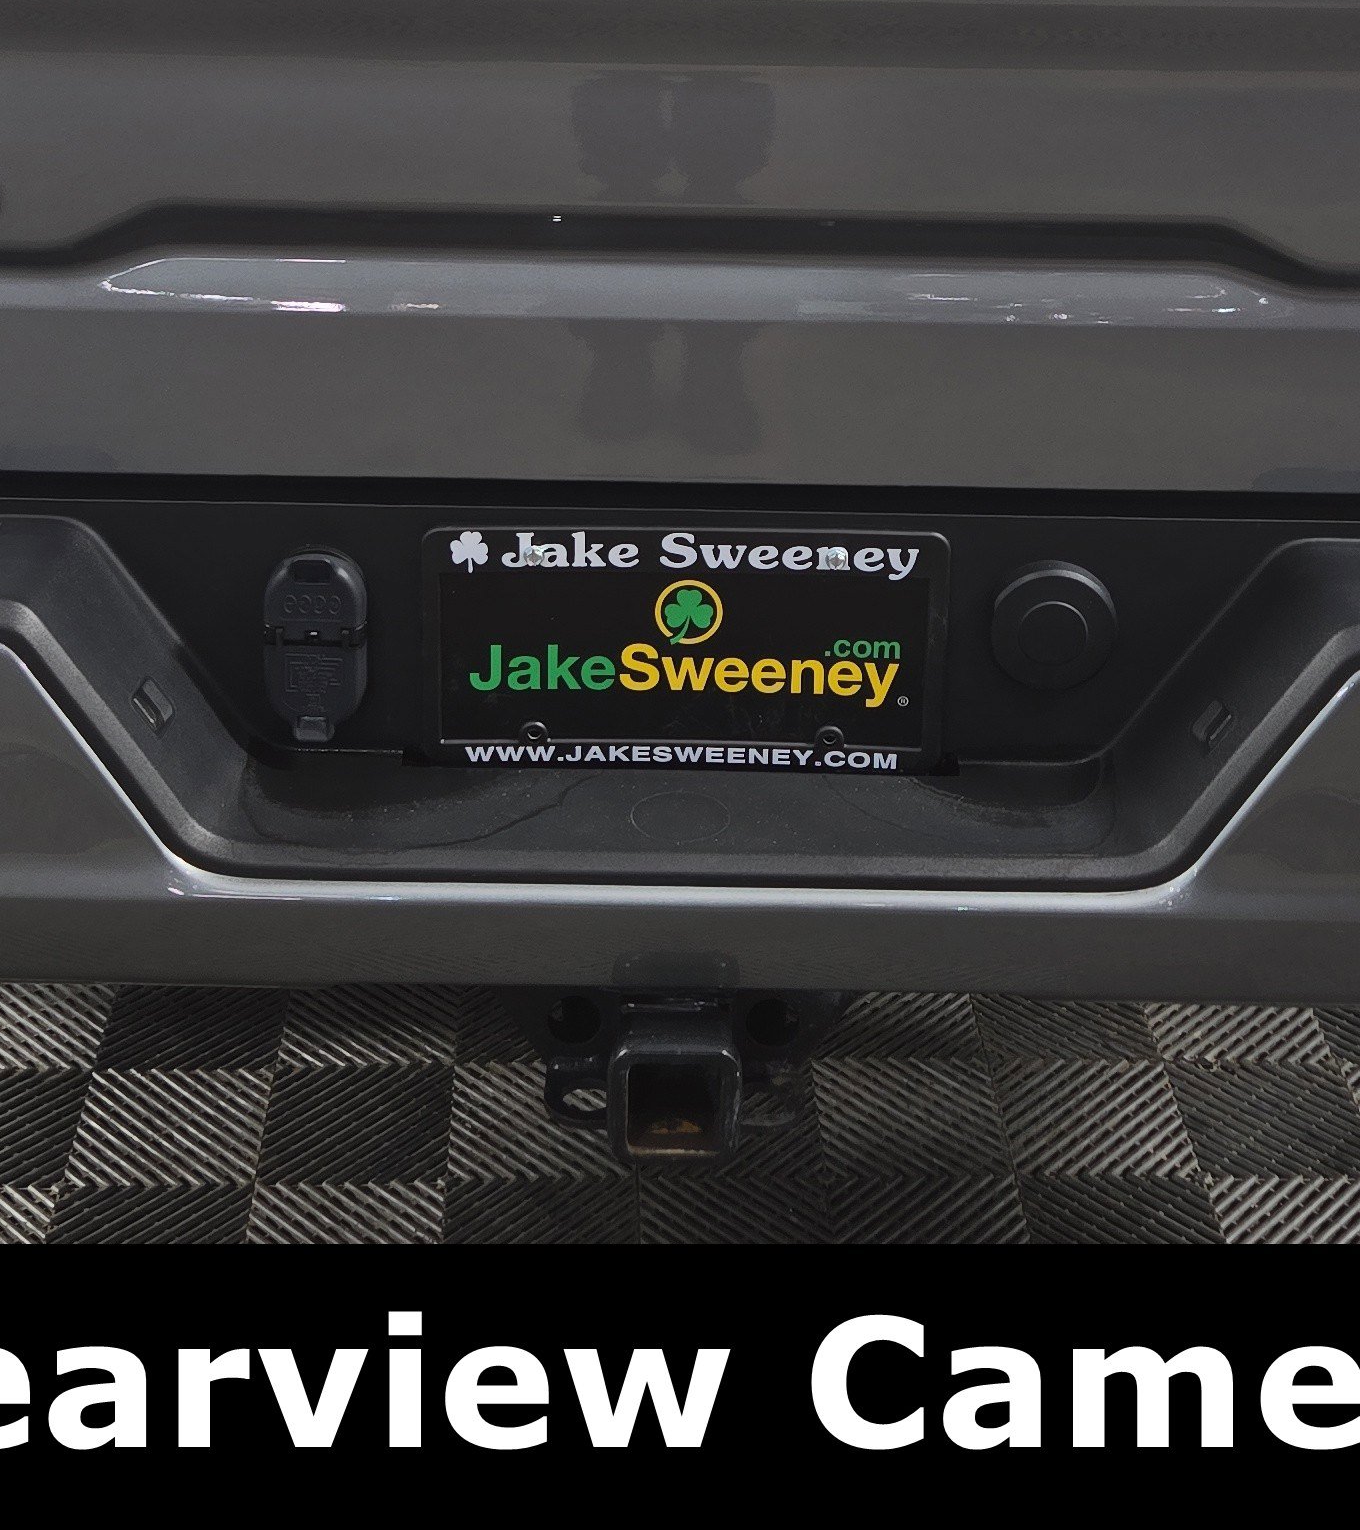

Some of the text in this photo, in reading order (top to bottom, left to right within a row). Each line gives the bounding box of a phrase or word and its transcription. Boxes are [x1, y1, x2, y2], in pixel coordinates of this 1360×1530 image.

[501, 531, 919, 581] Jake Sweeney
[464, 745, 899, 770] WWW.JAKESWEENEY.COM
